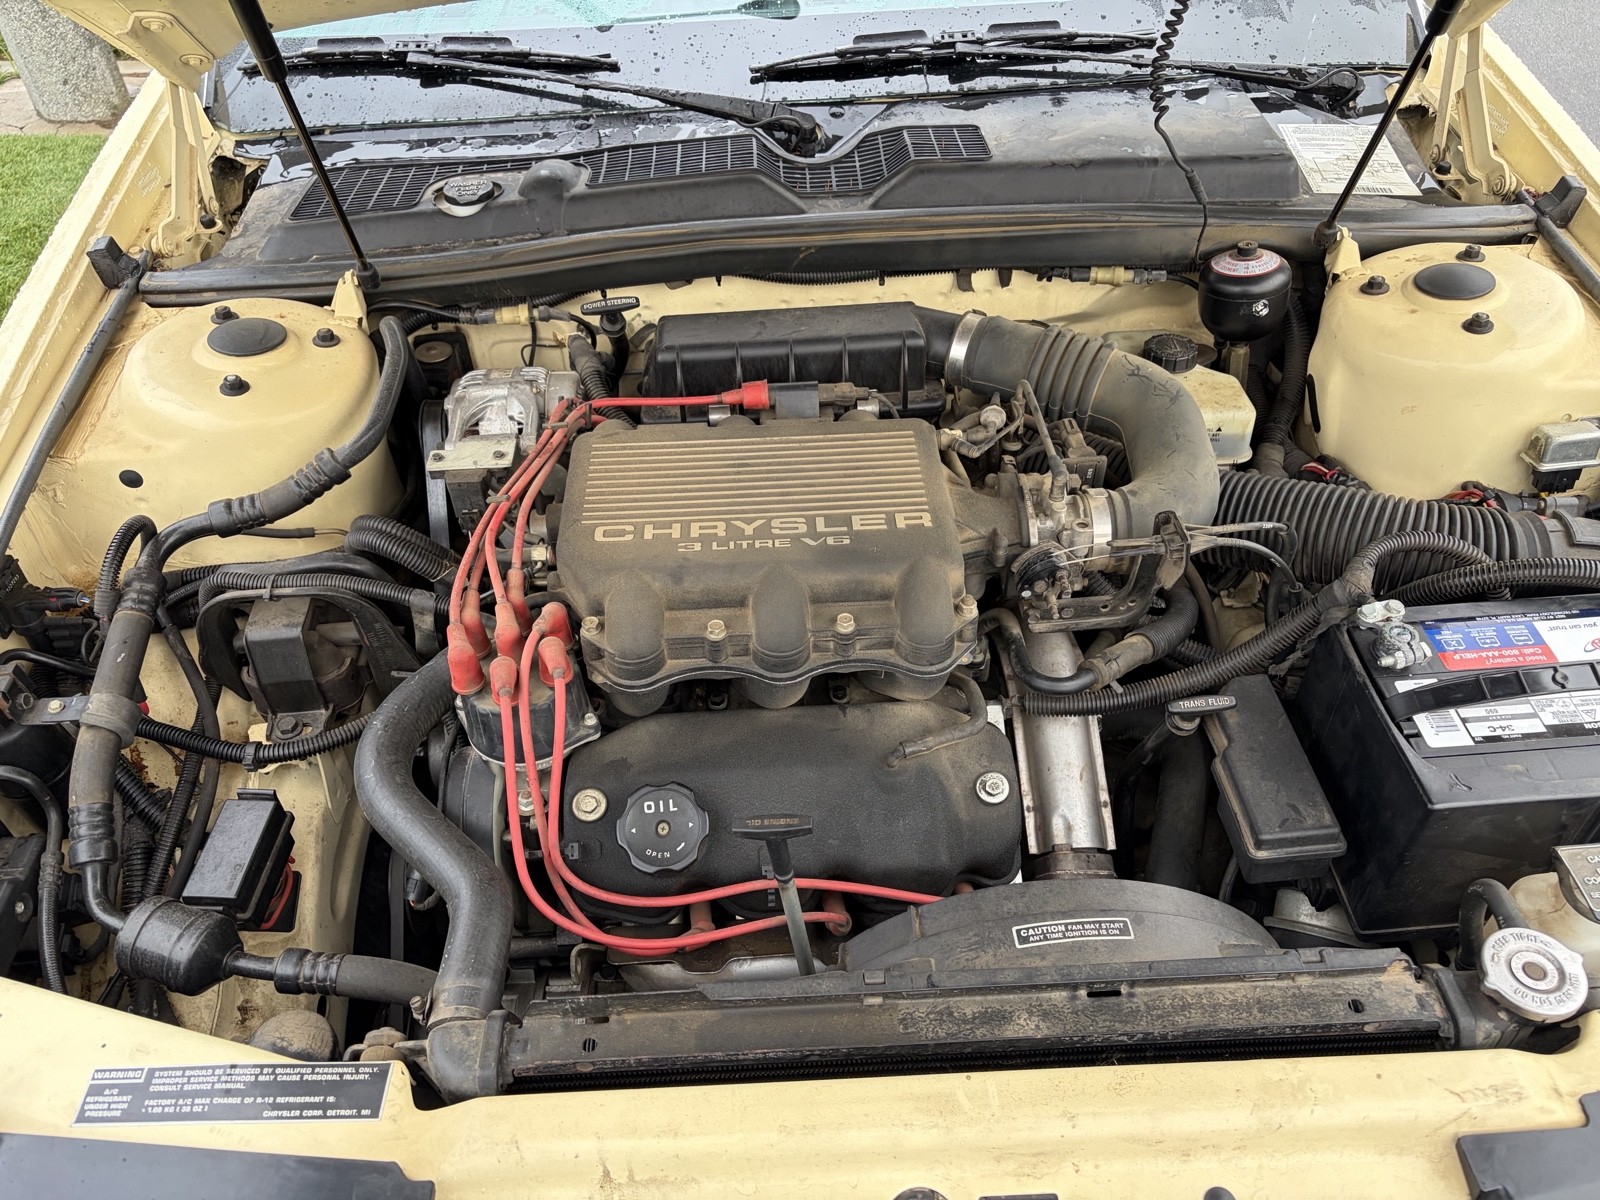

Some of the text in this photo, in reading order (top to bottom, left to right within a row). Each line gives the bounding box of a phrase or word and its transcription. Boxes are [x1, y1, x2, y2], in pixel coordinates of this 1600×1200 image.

[450, 180, 487, 188] WASHER
[583, 297, 636, 310] POWER STEERING
[594, 512, 933, 542] CHRYSLER
[677, 536, 850, 552] 3 LITRE V6
[1453, 650, 1519, 659] 800-AAA-HELP
[1179, 698, 1230, 709] TRANS FLUID
[644, 799, 678, 814] OIL
[646, 848, 670, 858] OPEN
[1020, 925, 1066, 937] CAUTION
[94, 1070, 142, 1079] WARNING
